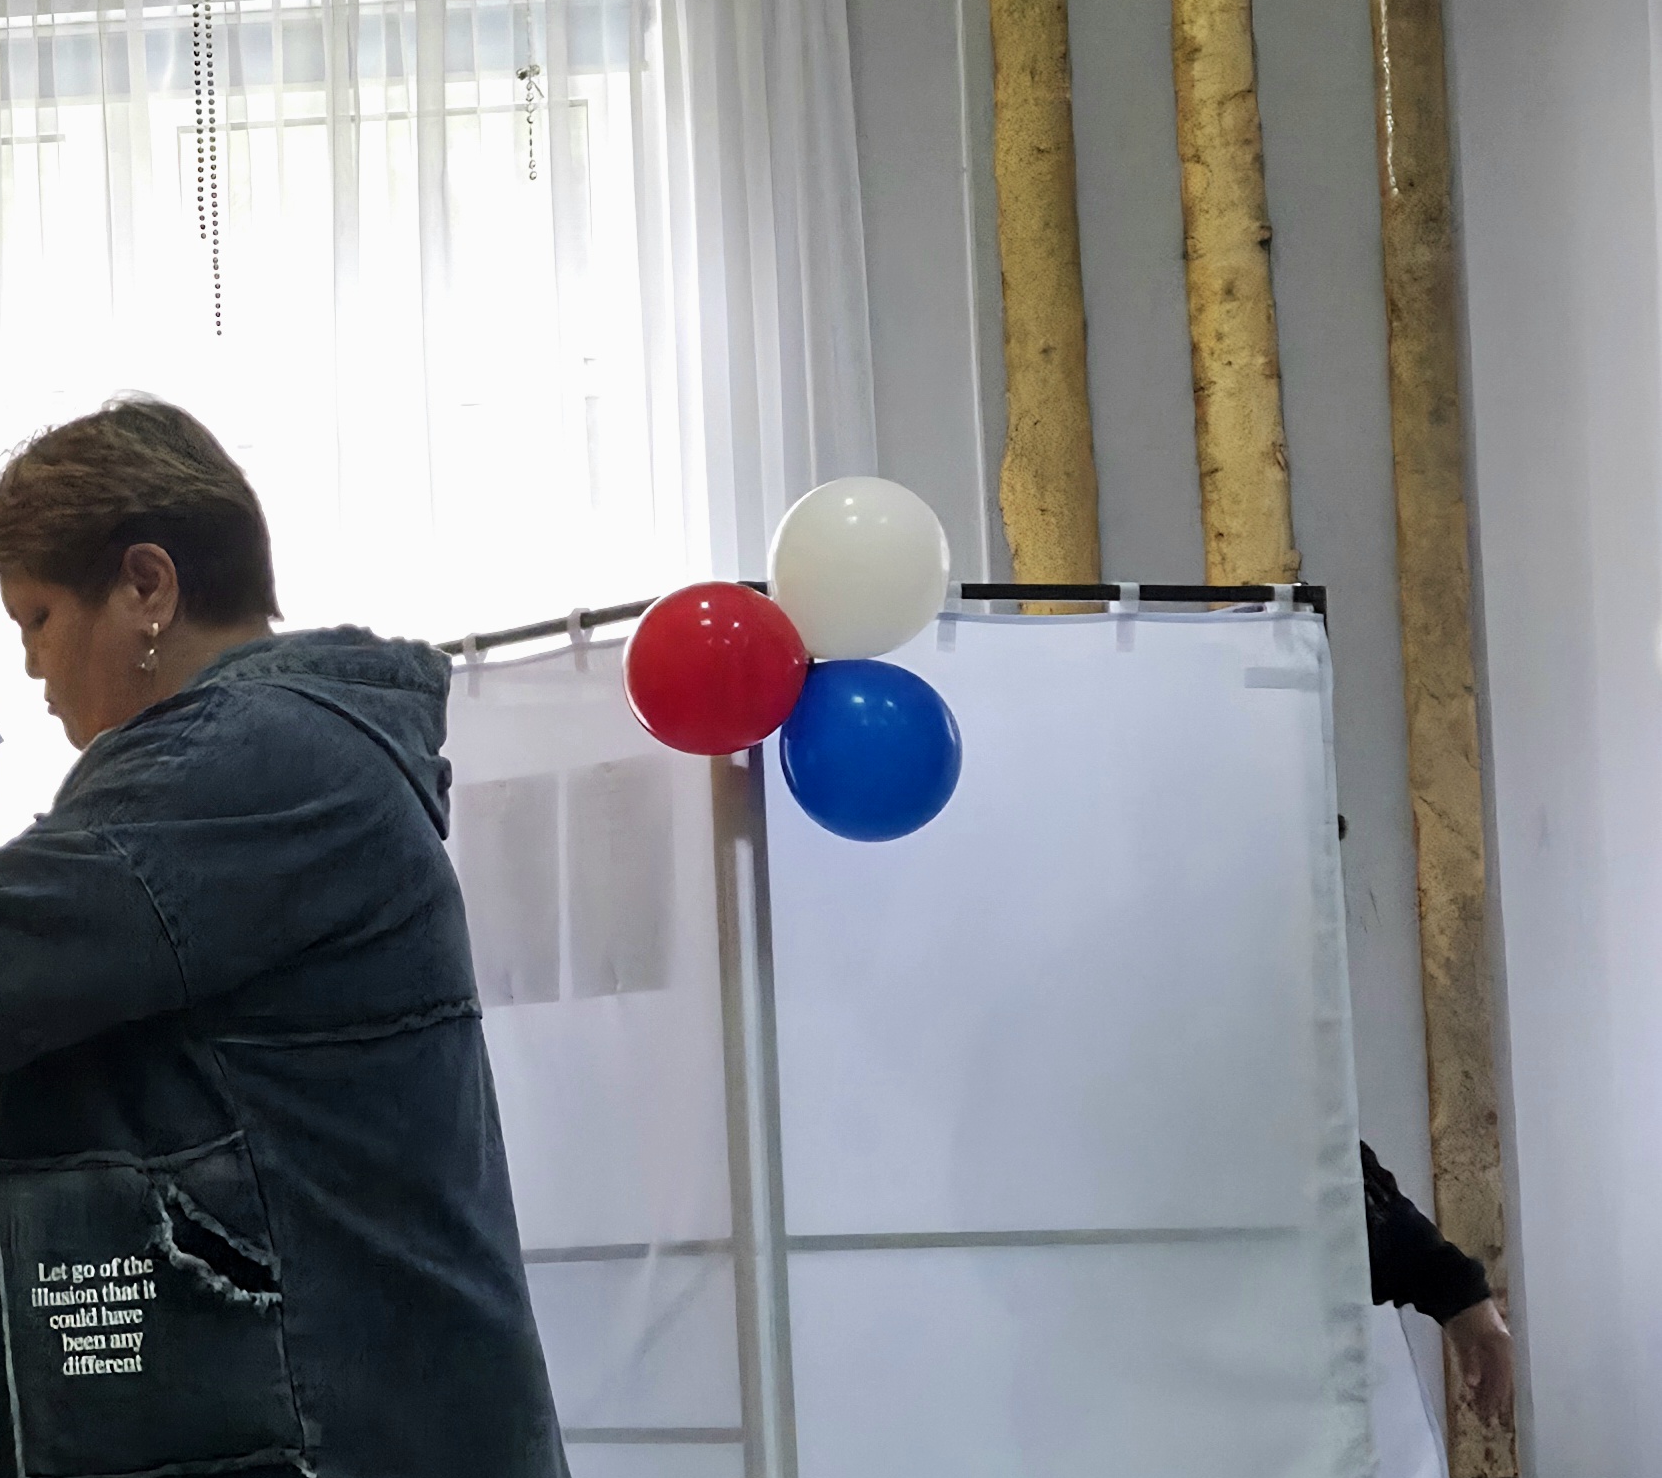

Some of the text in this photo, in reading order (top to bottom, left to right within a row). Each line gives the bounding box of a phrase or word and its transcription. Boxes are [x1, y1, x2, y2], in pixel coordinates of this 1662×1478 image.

[38, 1255, 154, 1284] Let go of the
[31, 1279, 157, 1307] illusion that it
[49, 1305, 143, 1329] could have
[61, 1331, 144, 1353] been any
[62, 1354, 143, 1376] different
